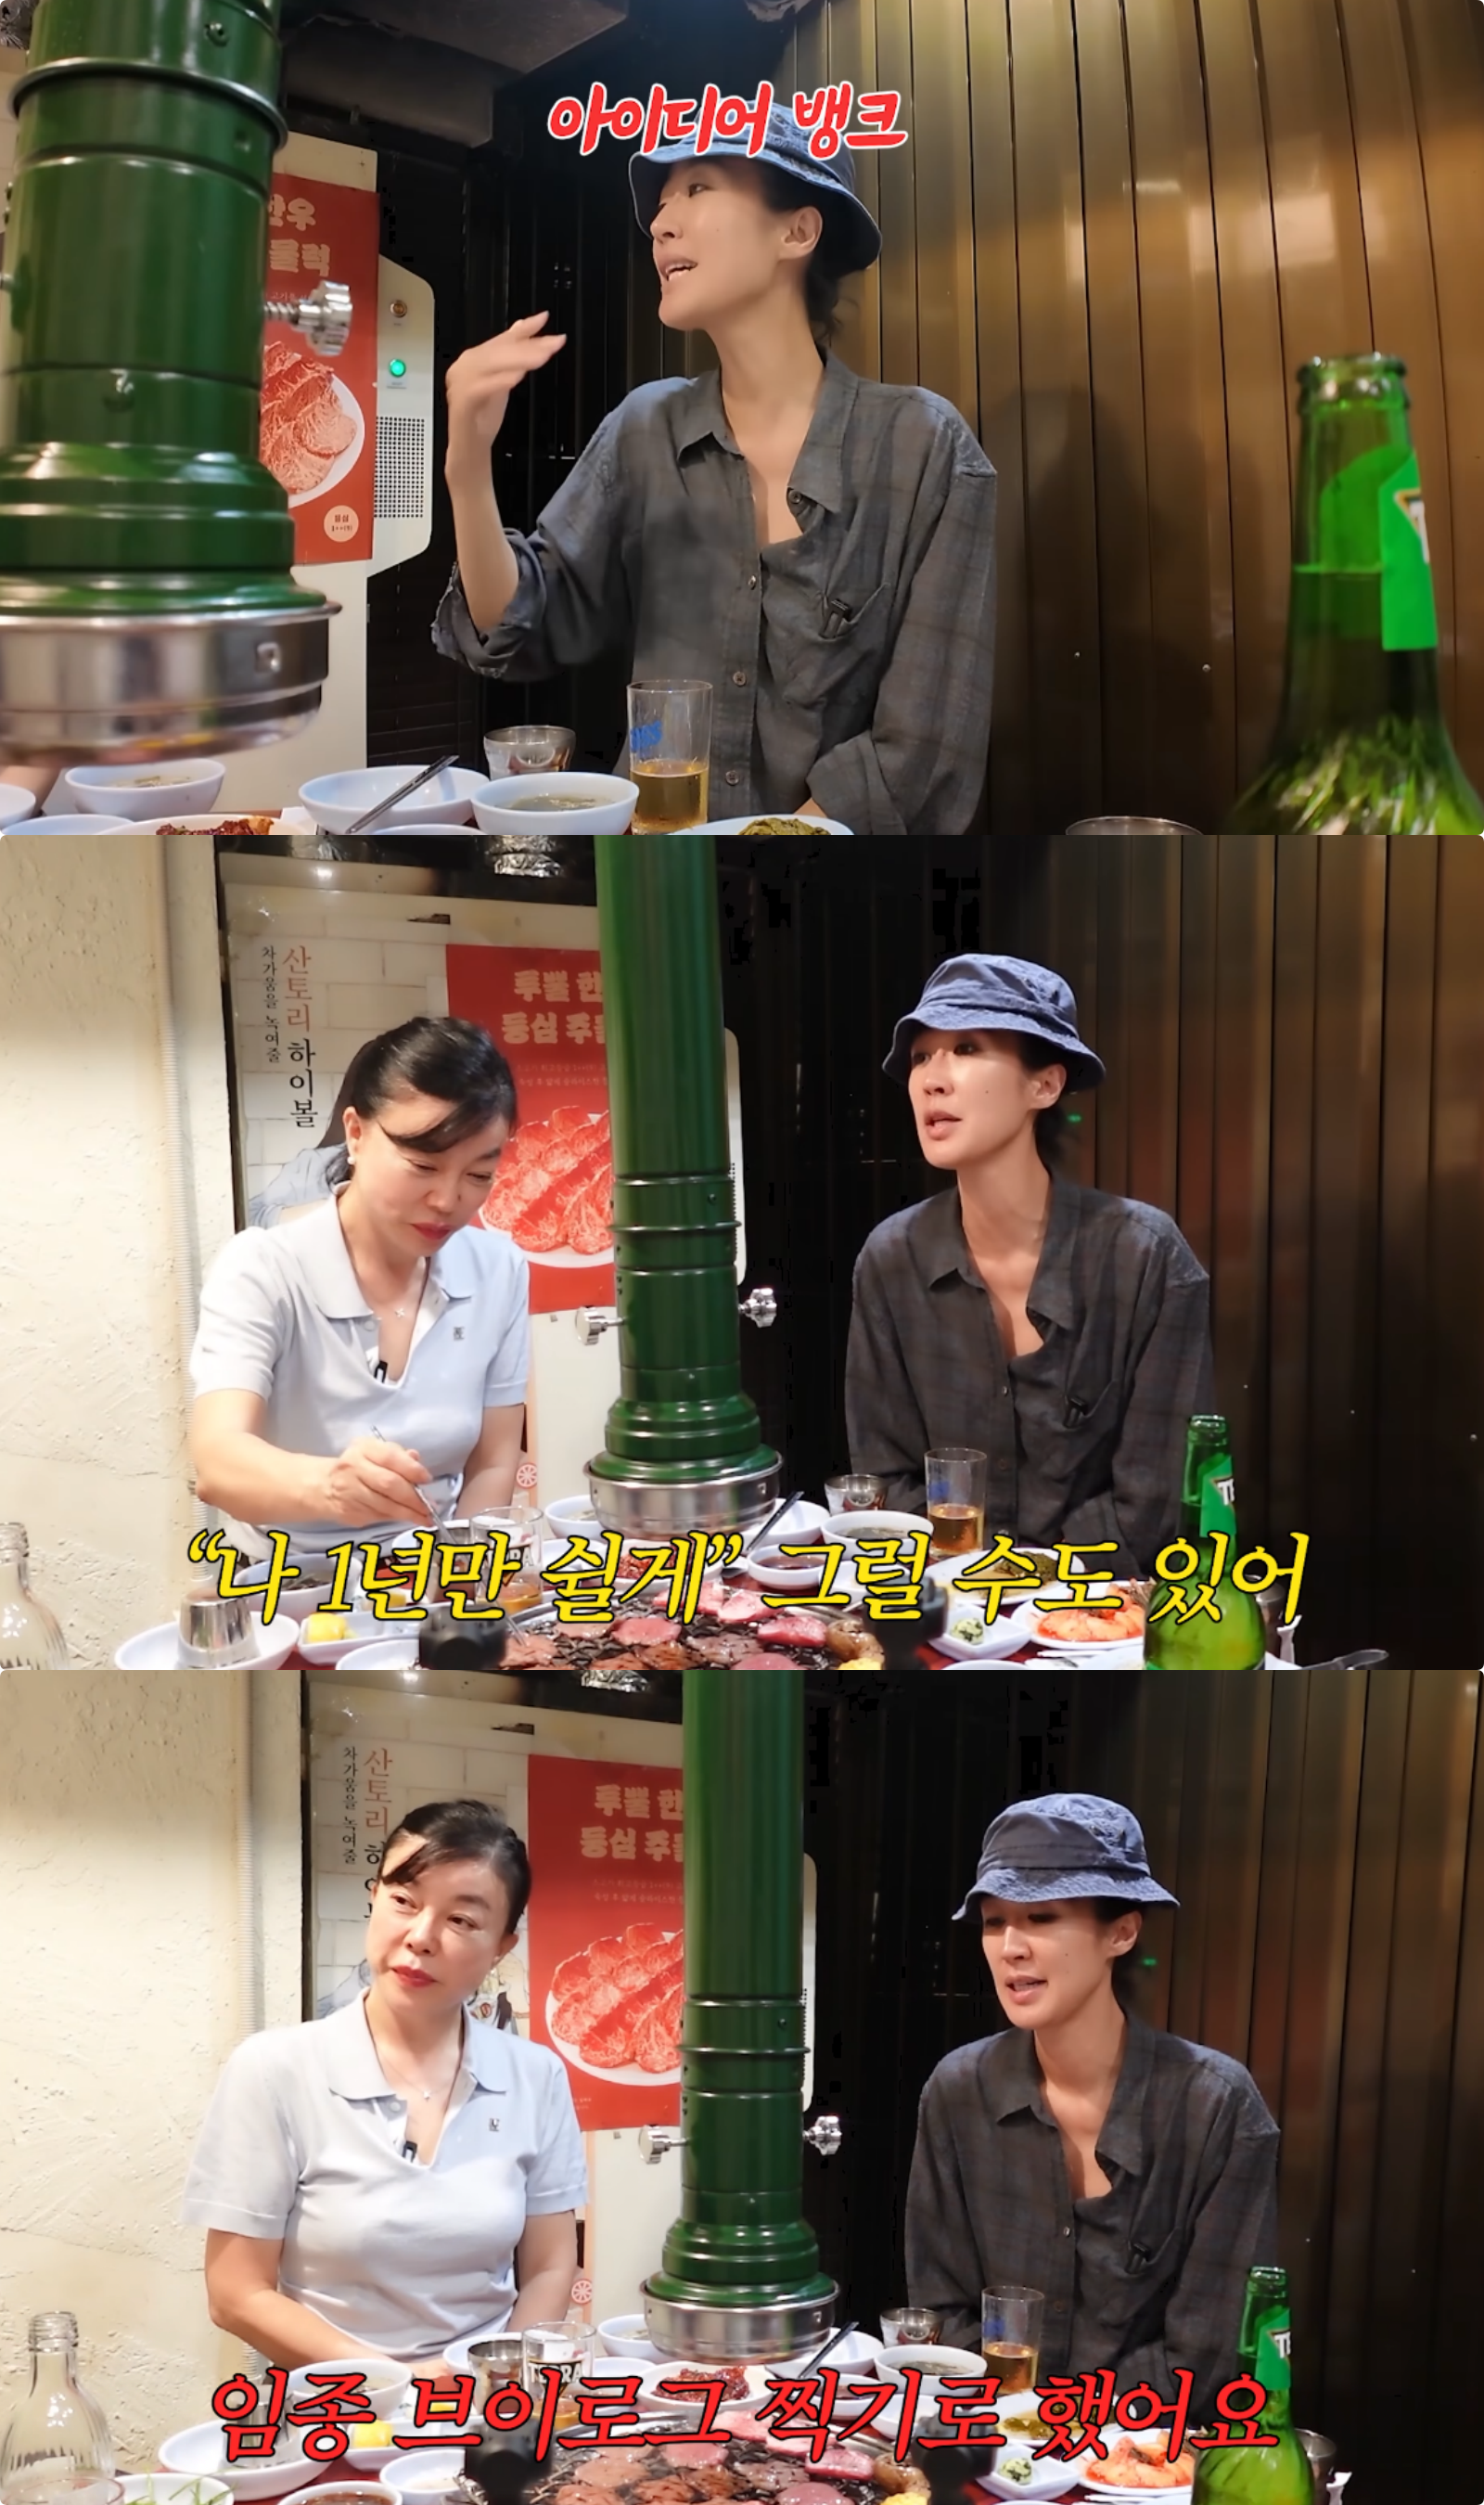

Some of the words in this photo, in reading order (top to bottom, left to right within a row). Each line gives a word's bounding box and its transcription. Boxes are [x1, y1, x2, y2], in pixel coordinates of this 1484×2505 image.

[283, 945, 313, 1033] 산토리
[514, 969, 570, 1002] 투뿔
[502, 1012, 557, 1045] 등심
[287, 1038, 318, 1128] 하이볼
[364, 1748, 392, 1835] 산토리
[595, 1784, 650, 1819] 투뿔
[580, 1826, 636, 1860] 등심
